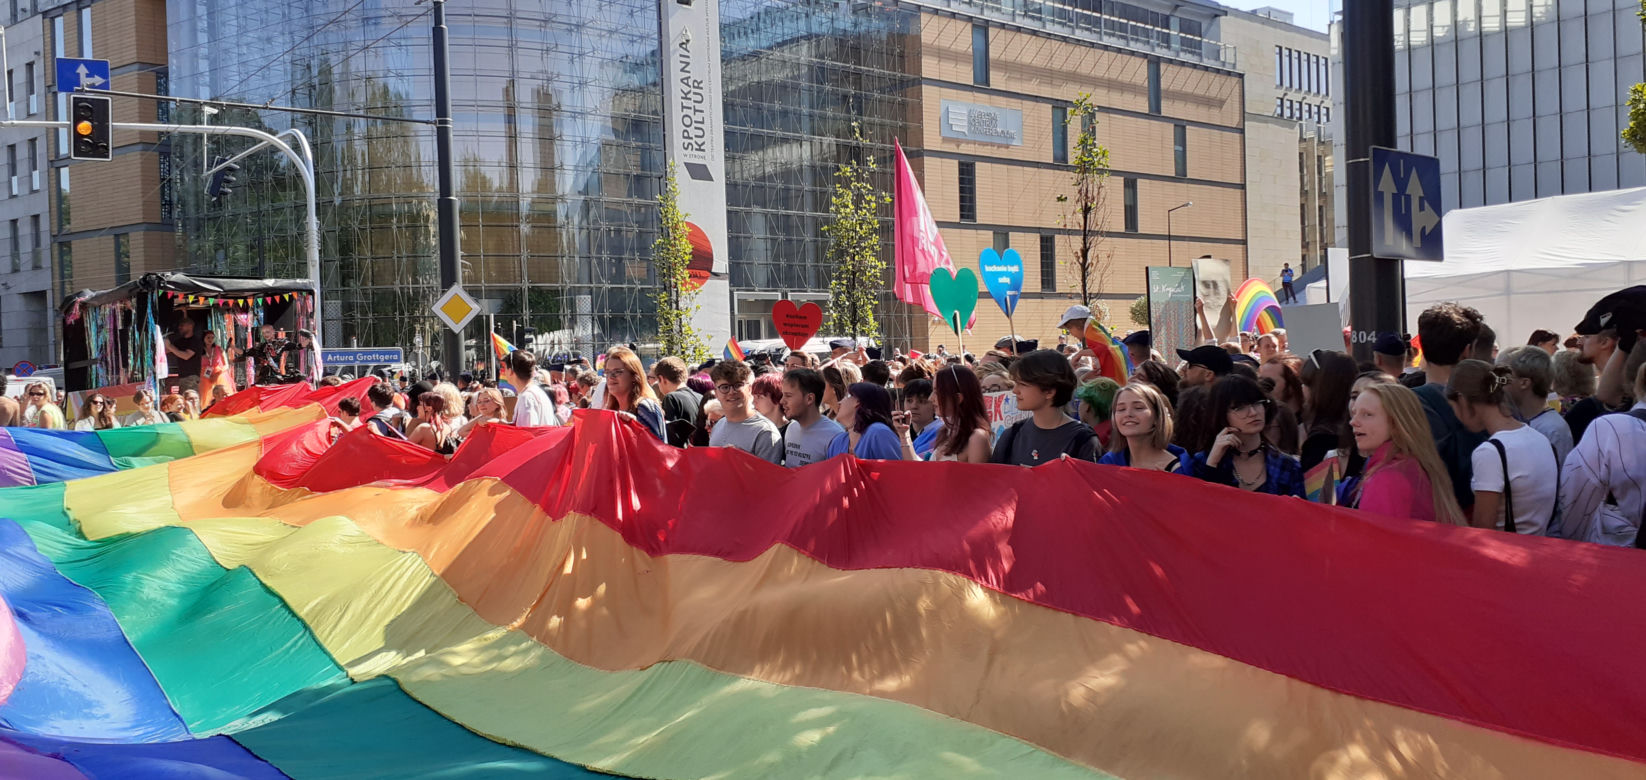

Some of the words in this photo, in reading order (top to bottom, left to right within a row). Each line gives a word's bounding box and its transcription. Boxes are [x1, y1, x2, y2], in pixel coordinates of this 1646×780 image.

[679, 40, 694, 152] SPOTKANIA
[692, 79, 706, 153] KULTUR
[327, 353, 354, 361] Artura
[356, 353, 398, 361] Grottgera
[1351, 330, 1377, 343] 804
